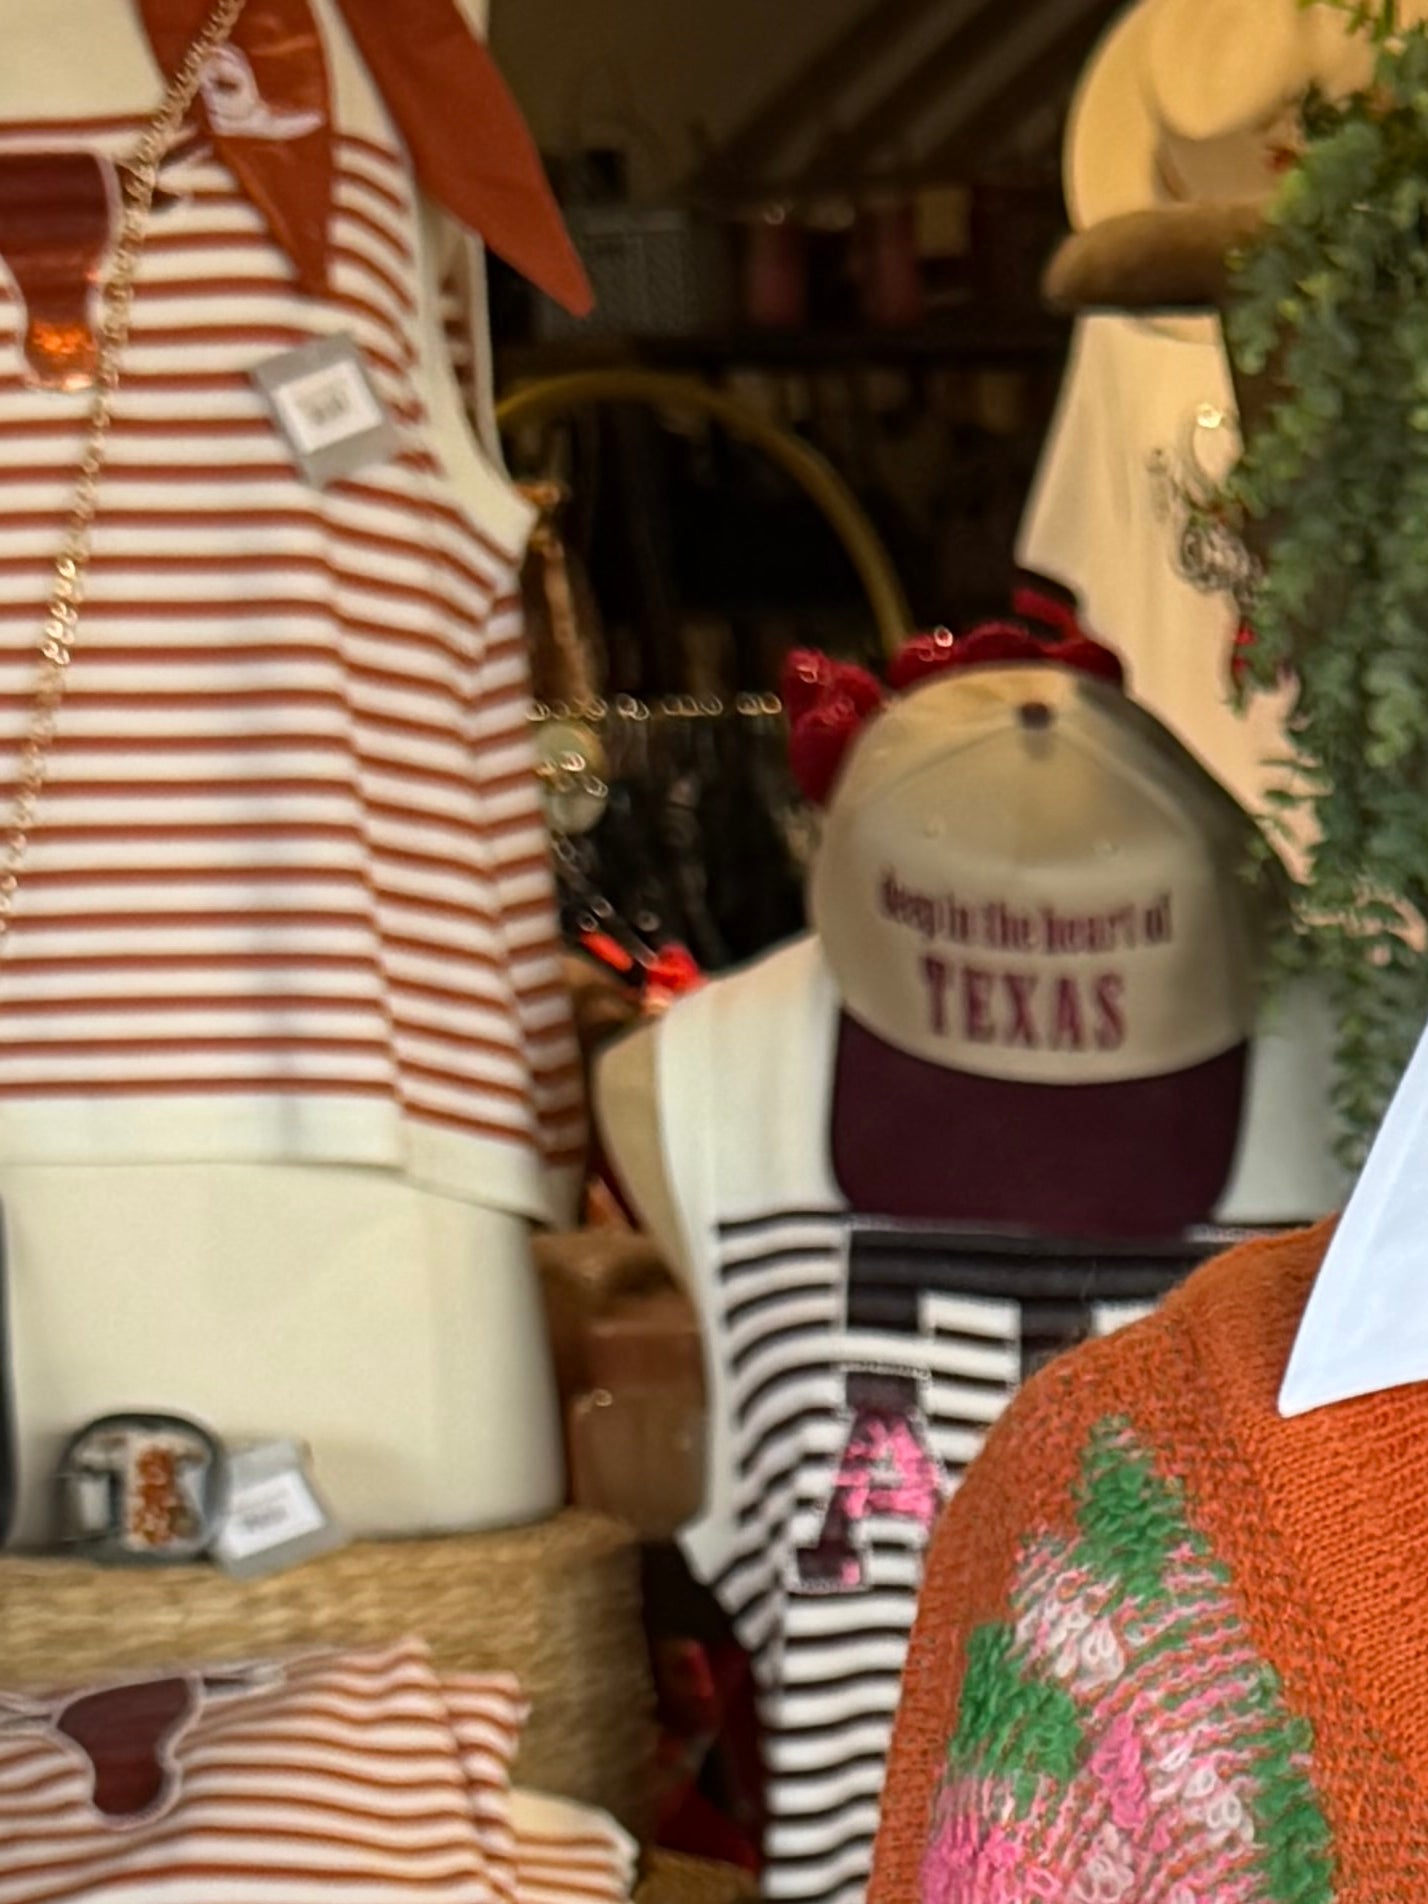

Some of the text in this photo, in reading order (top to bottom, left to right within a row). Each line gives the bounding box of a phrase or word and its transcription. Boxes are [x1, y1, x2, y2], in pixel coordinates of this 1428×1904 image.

[981, 898, 1036, 951] the
[1038, 902, 1137, 955] heart
[1143, 891, 1173, 945] of
[921, 952, 1126, 1053] TEXAS
